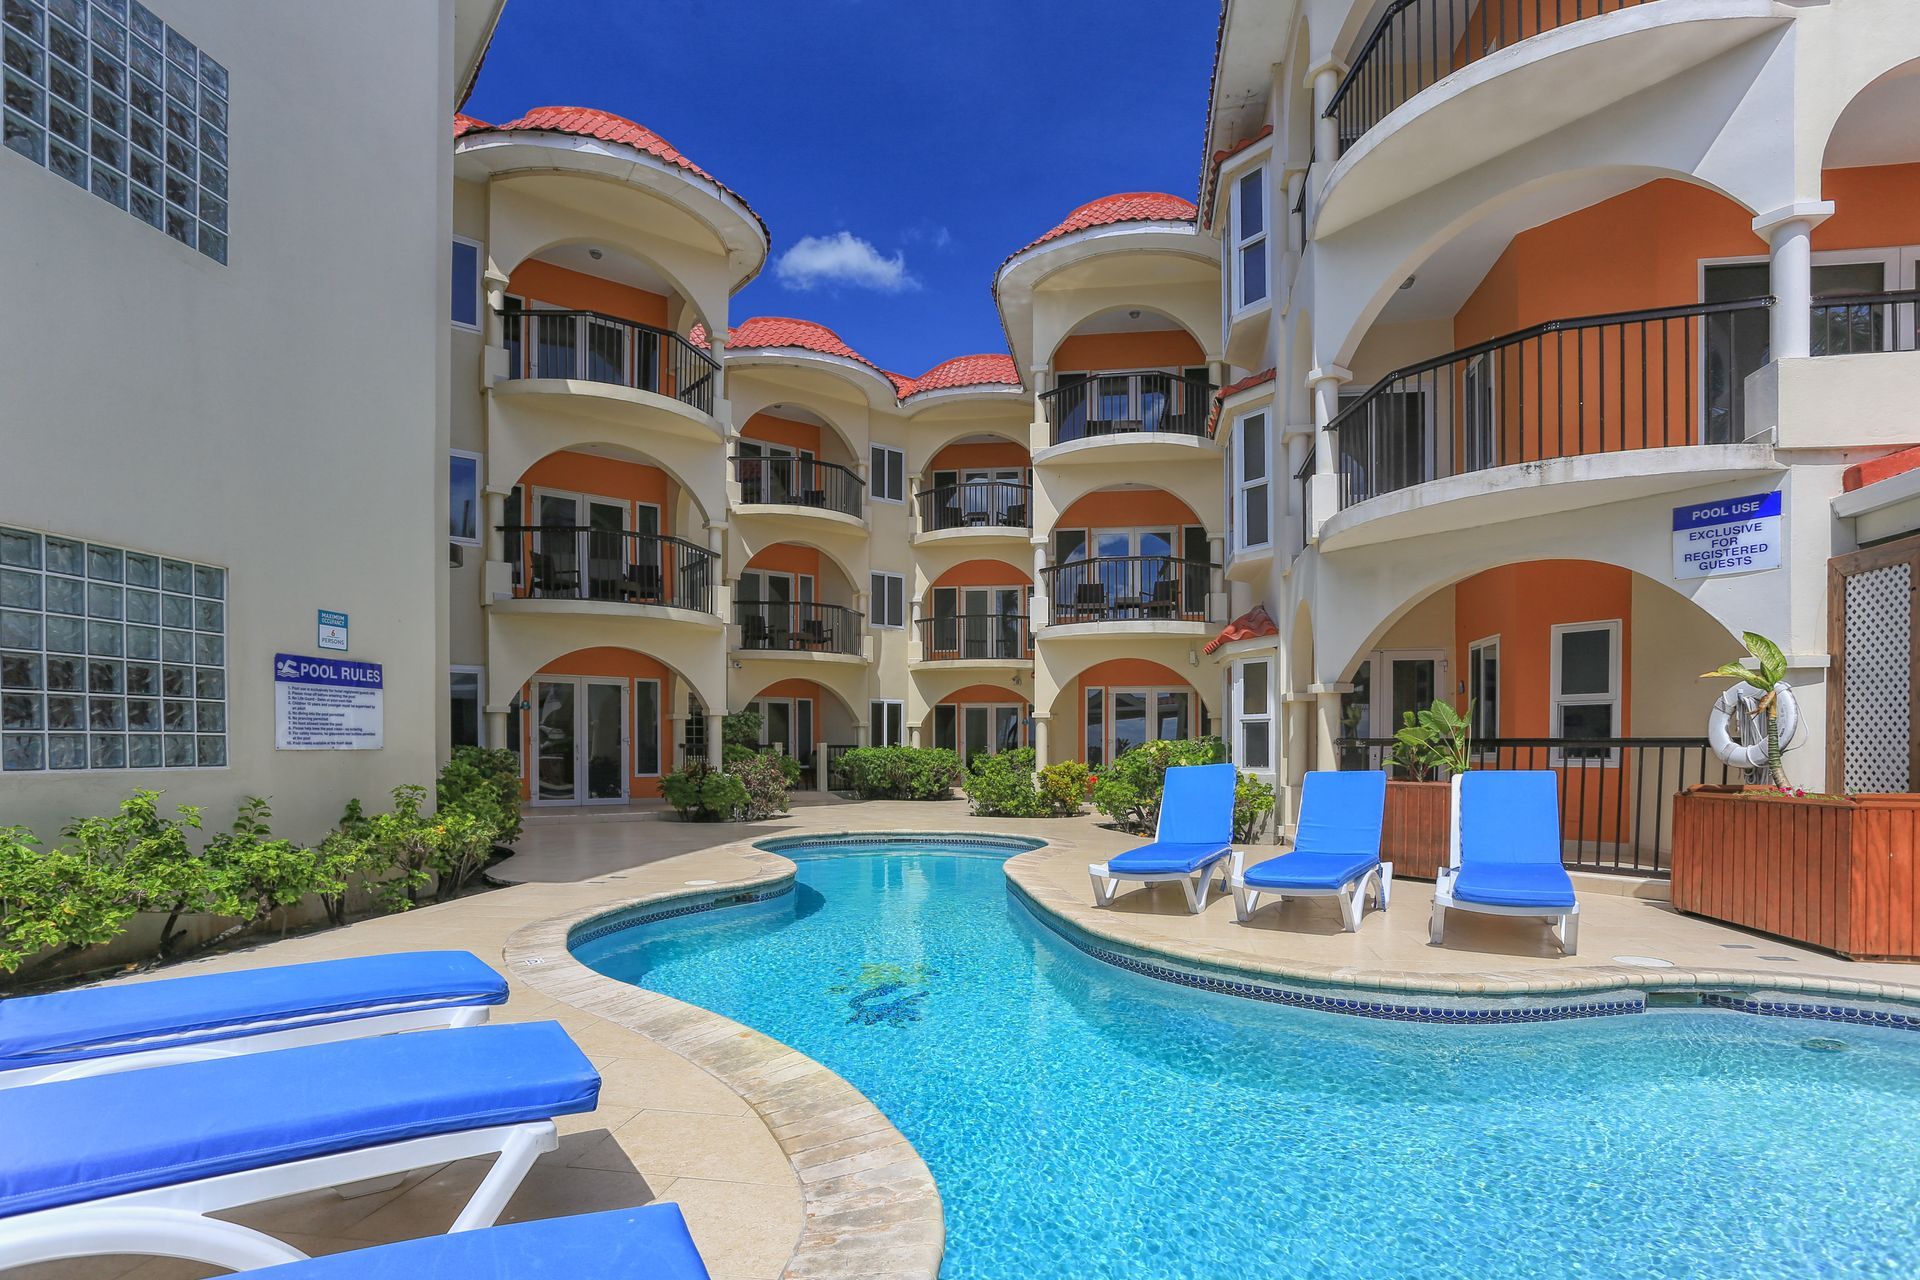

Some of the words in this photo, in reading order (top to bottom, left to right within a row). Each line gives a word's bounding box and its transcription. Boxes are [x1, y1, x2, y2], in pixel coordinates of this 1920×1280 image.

[1692, 507, 1729, 521] POOL
[1731, 501, 1760, 514] USE
[1689, 522, 1763, 541] EXCLUSIVE
[1711, 537, 1738, 548] FOR
[1684, 543, 1769, 563] REGISTERED
[1699, 556, 1752, 571] GUESTS
[321, 612, 345, 621] MAXIMUM
[321, 618, 345, 626] OCCUPANCY
[330, 629, 336, 637] 6
[321, 637, 345, 645] PERSONS
[300, 662, 338, 679] POOL
[341, 667, 381, 683] RULES
